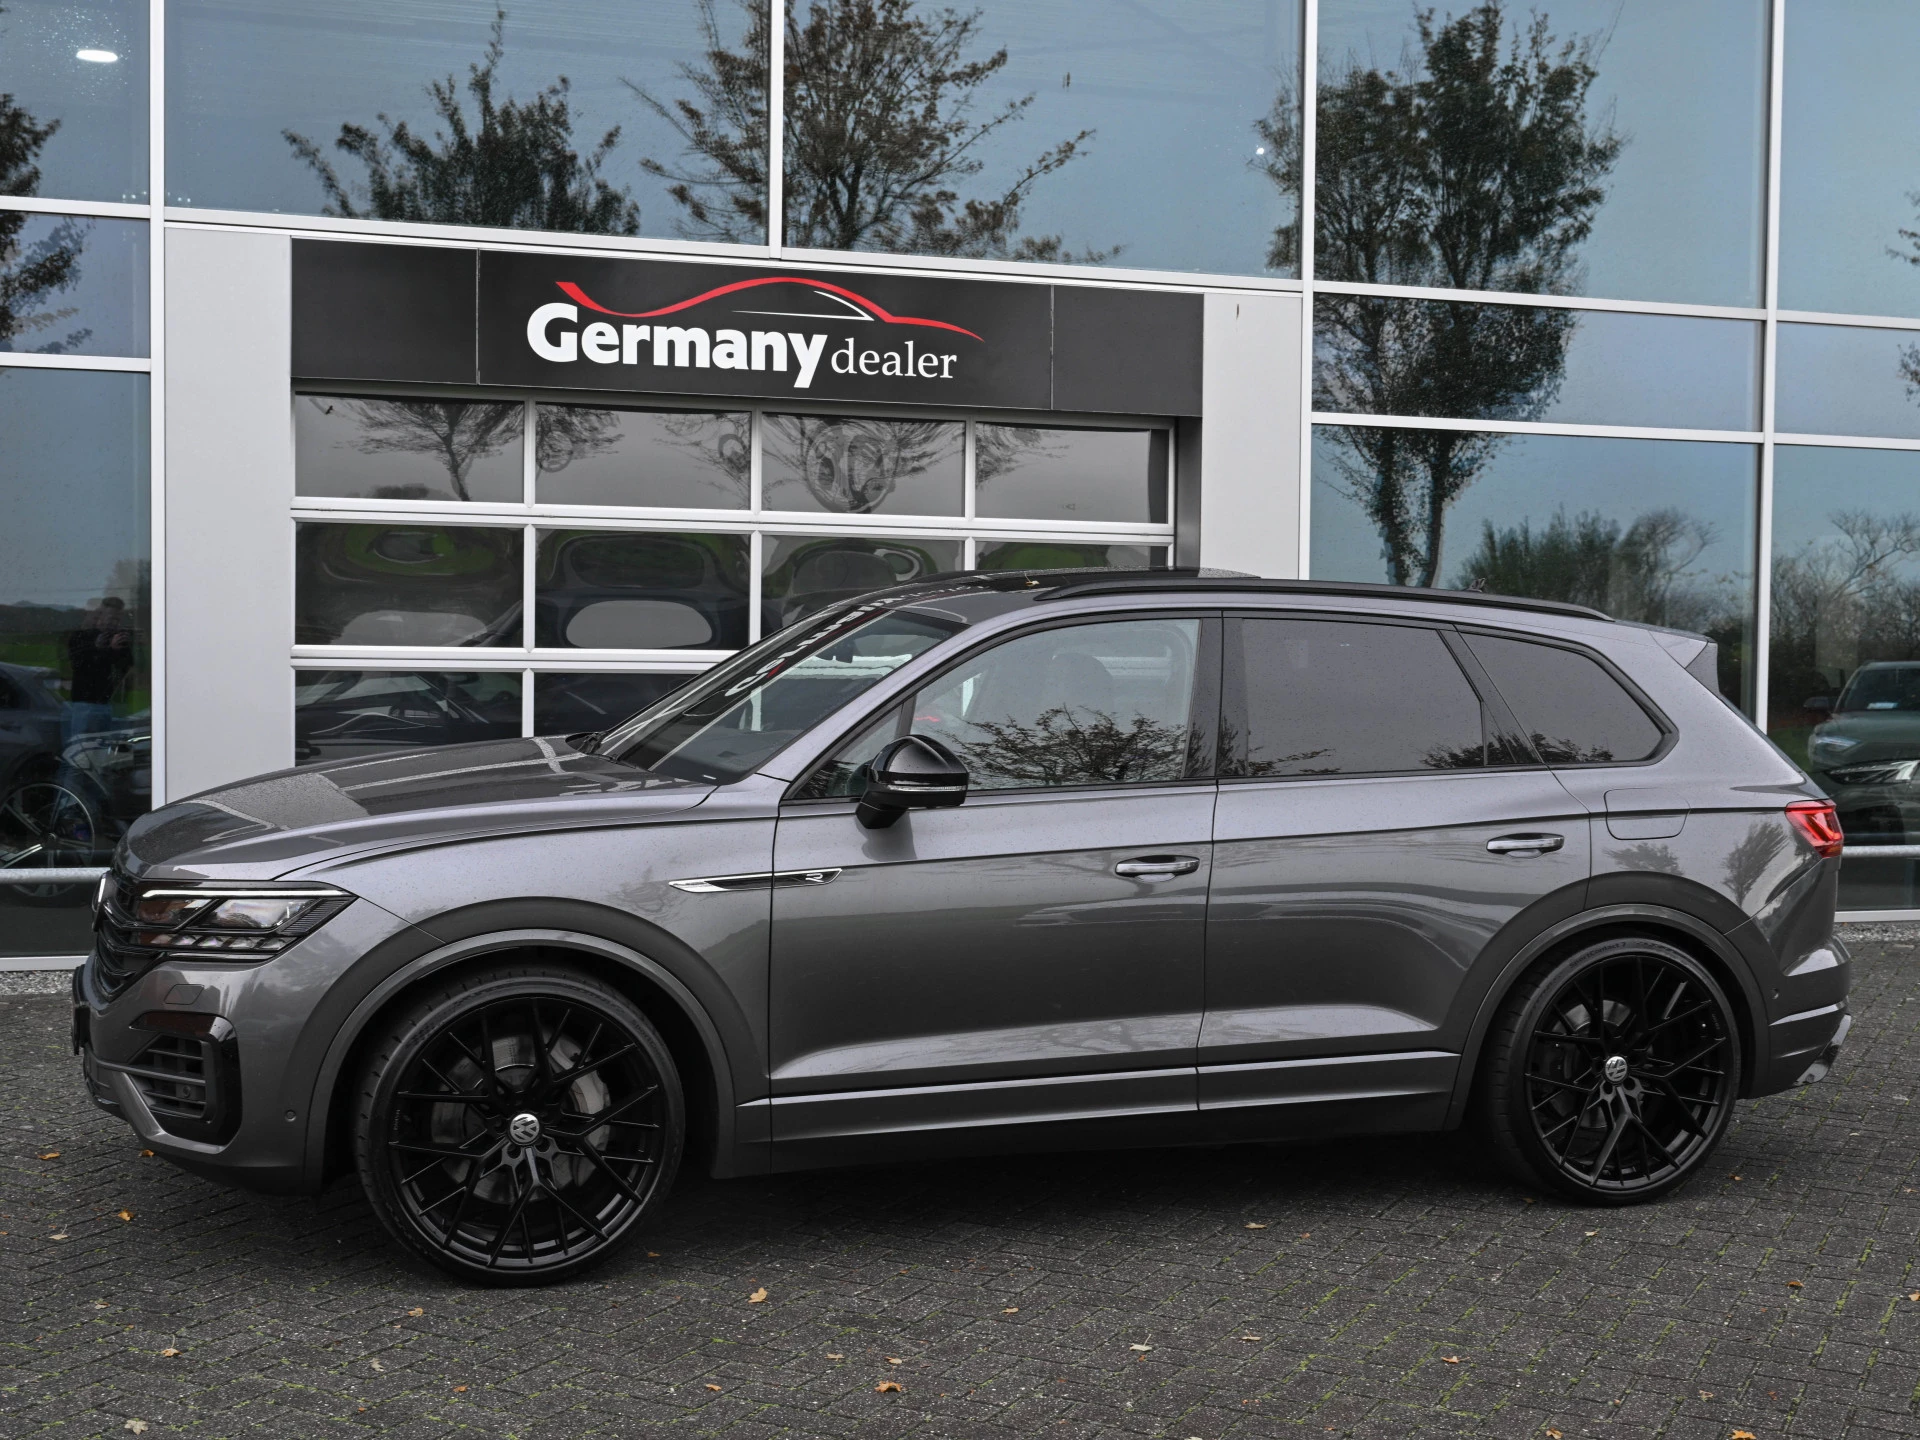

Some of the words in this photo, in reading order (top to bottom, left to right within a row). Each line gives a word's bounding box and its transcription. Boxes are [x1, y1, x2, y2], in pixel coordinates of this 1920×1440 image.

[526, 302, 828, 389] Germany
[830, 337, 958, 379] dealer
[1568, 942, 1620, 969] SportContact
